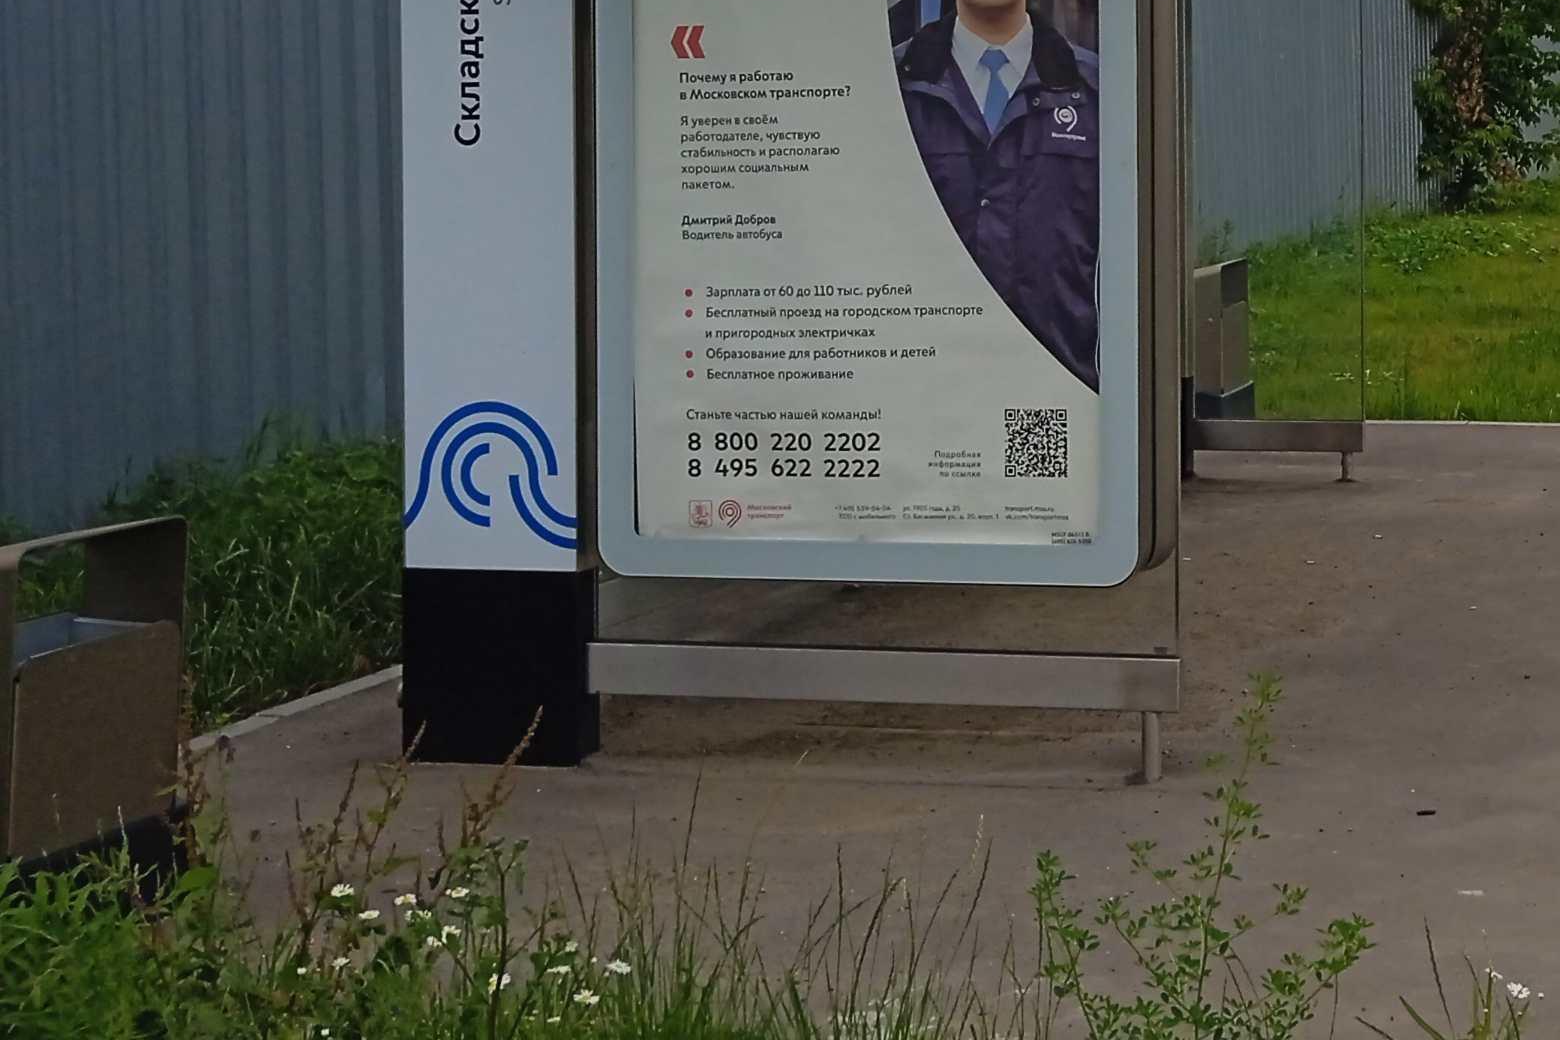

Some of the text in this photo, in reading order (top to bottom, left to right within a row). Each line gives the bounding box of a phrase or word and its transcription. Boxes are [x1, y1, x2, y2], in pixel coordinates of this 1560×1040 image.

[680, 71, 793, 86] Почему я работаю
[680, 85, 850, 100] в Московском транспорте?
[681, 114, 778, 129] Я уверен в своём
[681, 130, 820, 144] работодателе, чувствую
[681, 147, 757, 158] стабильность
[769, 145, 840, 158] располагаю
[682, 164, 809, 175] хорошим социальным
[682, 181, 735, 189] пакетом.
[682, 214, 776, 228] Дмитрий Добров
[682, 228, 782, 240] Водитель автобуса
[706, 284, 912, 299] Зарплата от 60 до 110 тыс. рублей
[706, 307, 776, 318] Бесплатный
[780, 307, 822, 319] проезд
[843, 308, 911, 318] городском
[914, 307, 983, 318] транспорте
[715, 330, 795, 340] пригородных
[799, 328, 875, 340] электричках
[706, 347, 935, 361] Образование для работников и детей
[707, 369, 853, 381] Бесплатное проживание
[686, 409, 881, 421] Станьте частью нашей команды!
[688, 432, 880, 451] 8 800 220 2202
[688, 458, 880, 477] 8 495 622 2222
